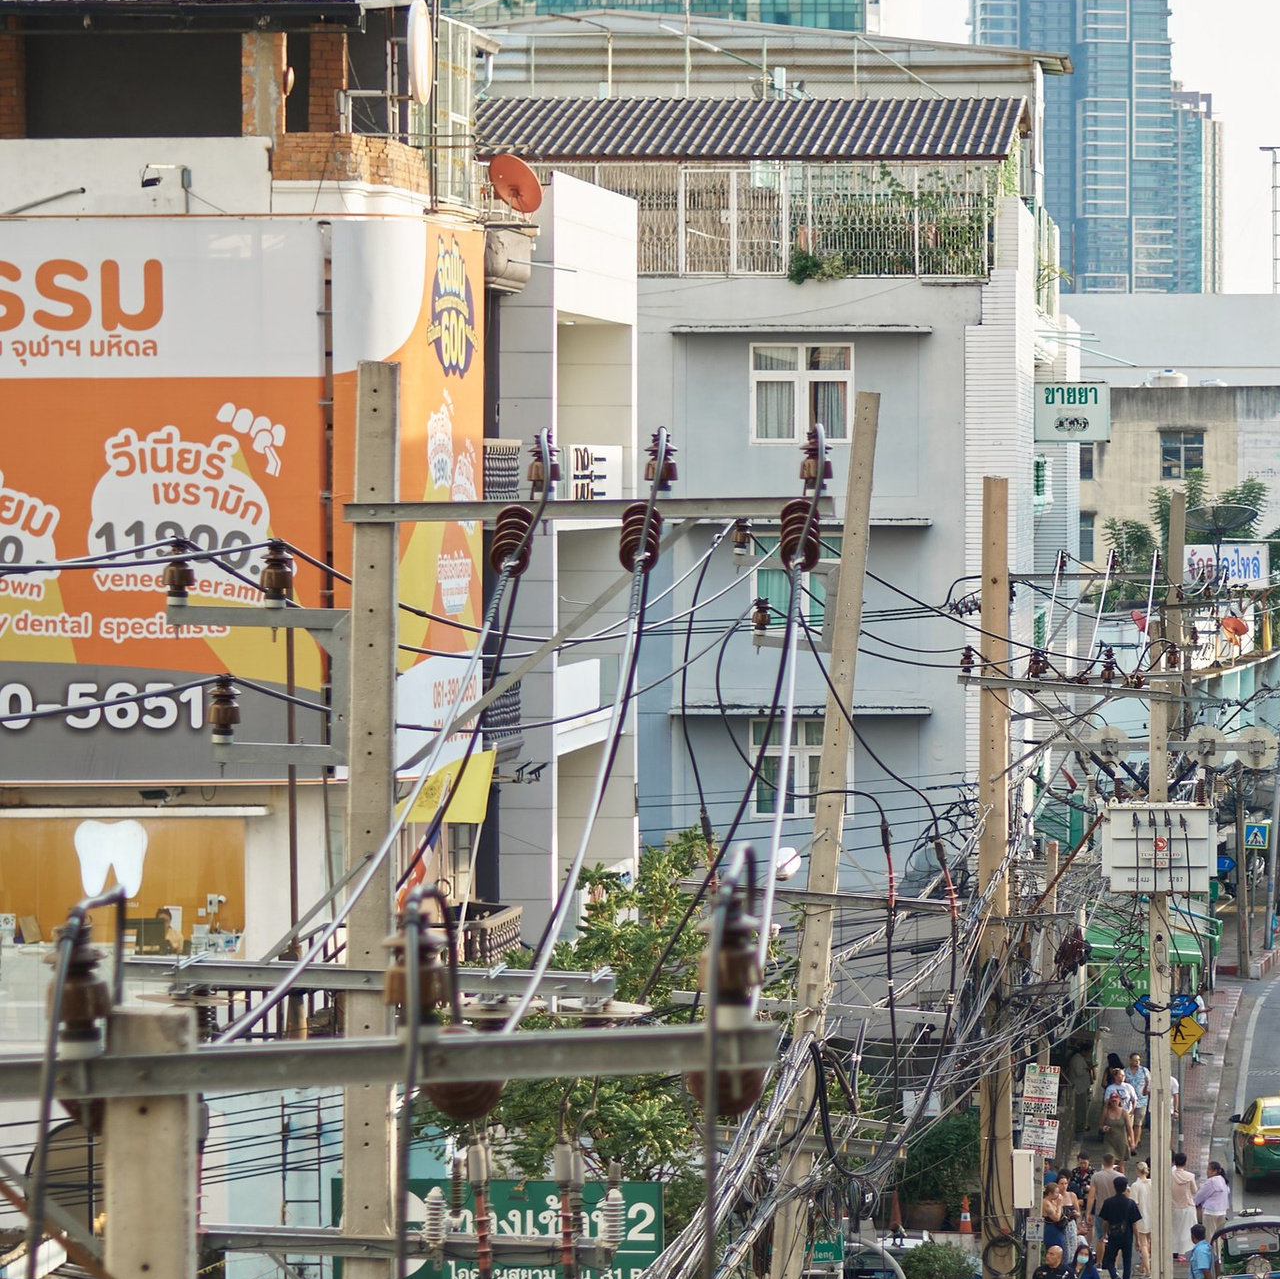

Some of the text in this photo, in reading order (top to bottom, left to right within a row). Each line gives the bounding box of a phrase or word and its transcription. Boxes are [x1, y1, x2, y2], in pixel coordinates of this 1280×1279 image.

[11, 334, 158, 367] จุฬาฯ มหิดล
[441, 309, 466, 371] 600
[1044, 386, 1098, 405] ขายยา
[111, 431, 232, 480] วีเนียร์
[152, 482, 263, 526] เซรามิก
[191, 578, 267, 605] cerami
[14, 612, 89, 636] dental
[1108, 975, 1148, 990] Sim
[626, 1202, 656, 1241] 2
